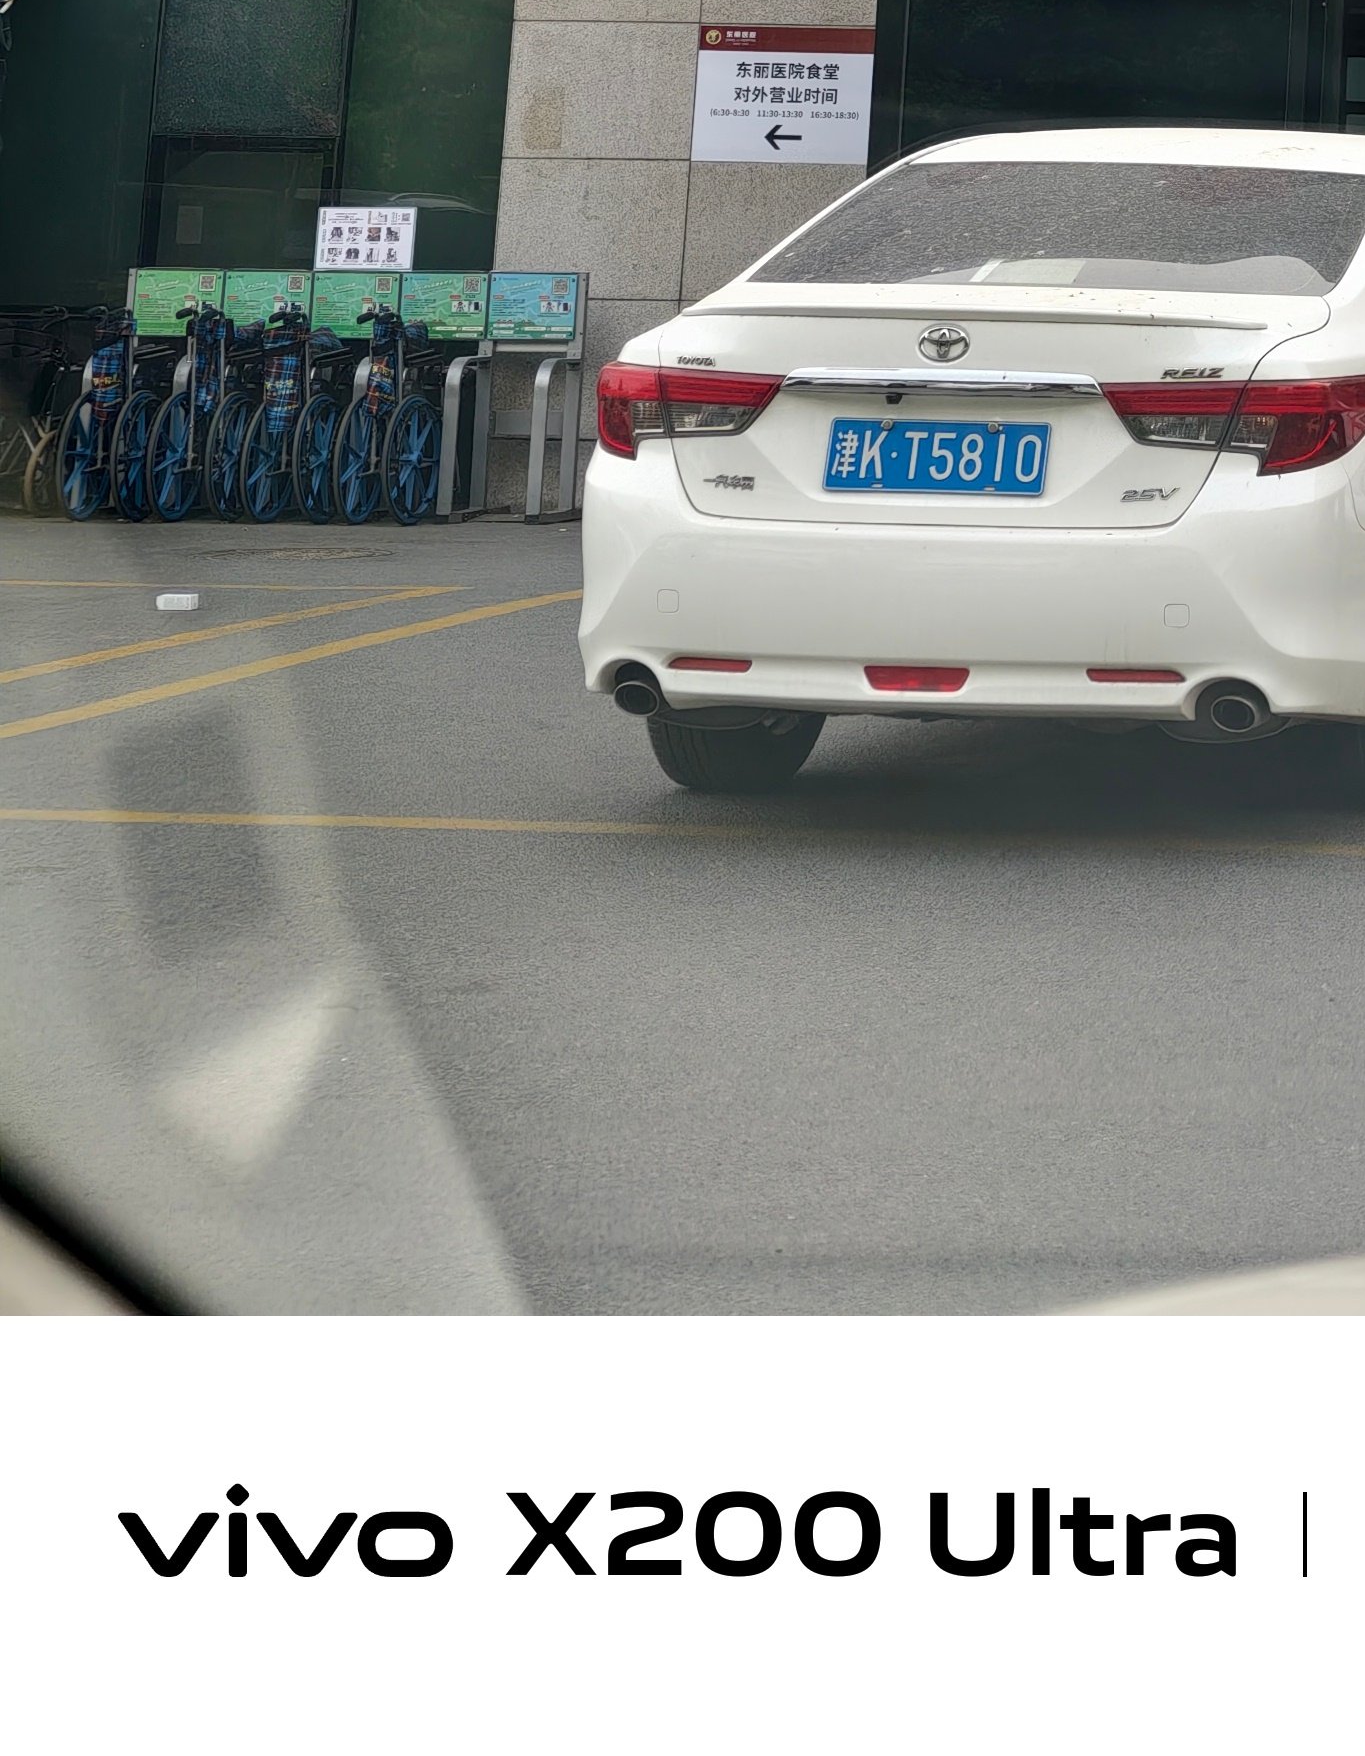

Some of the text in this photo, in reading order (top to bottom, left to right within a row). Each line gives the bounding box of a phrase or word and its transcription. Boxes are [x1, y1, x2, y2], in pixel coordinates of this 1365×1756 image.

[736, 61, 840, 80] 东丽医院食堂
[733, 86, 838, 105] 对外营业时间
[757, 110, 804, 119] 11:30-13:30
[677, 355, 716, 367] TOYOTA
[1160, 367, 1225, 380] REIZ
[831, 430, 1042, 483] 津K·T5810
